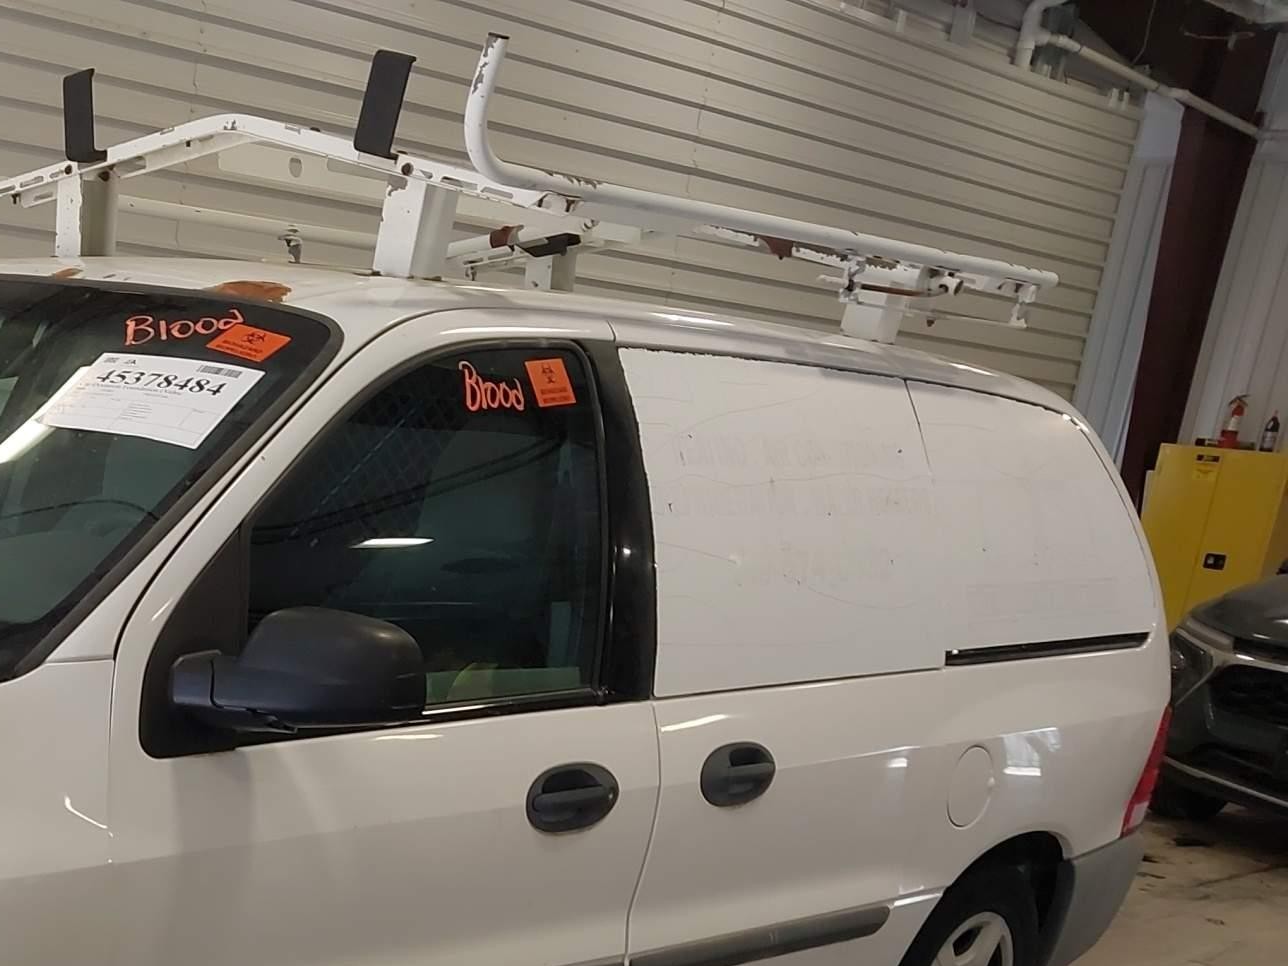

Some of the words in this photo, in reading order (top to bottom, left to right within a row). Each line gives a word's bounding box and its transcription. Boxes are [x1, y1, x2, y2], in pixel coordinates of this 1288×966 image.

[124, 308, 245, 347] Blood
[96, 369, 227, 396] 45378484
[458, 360, 525, 412] Blood
